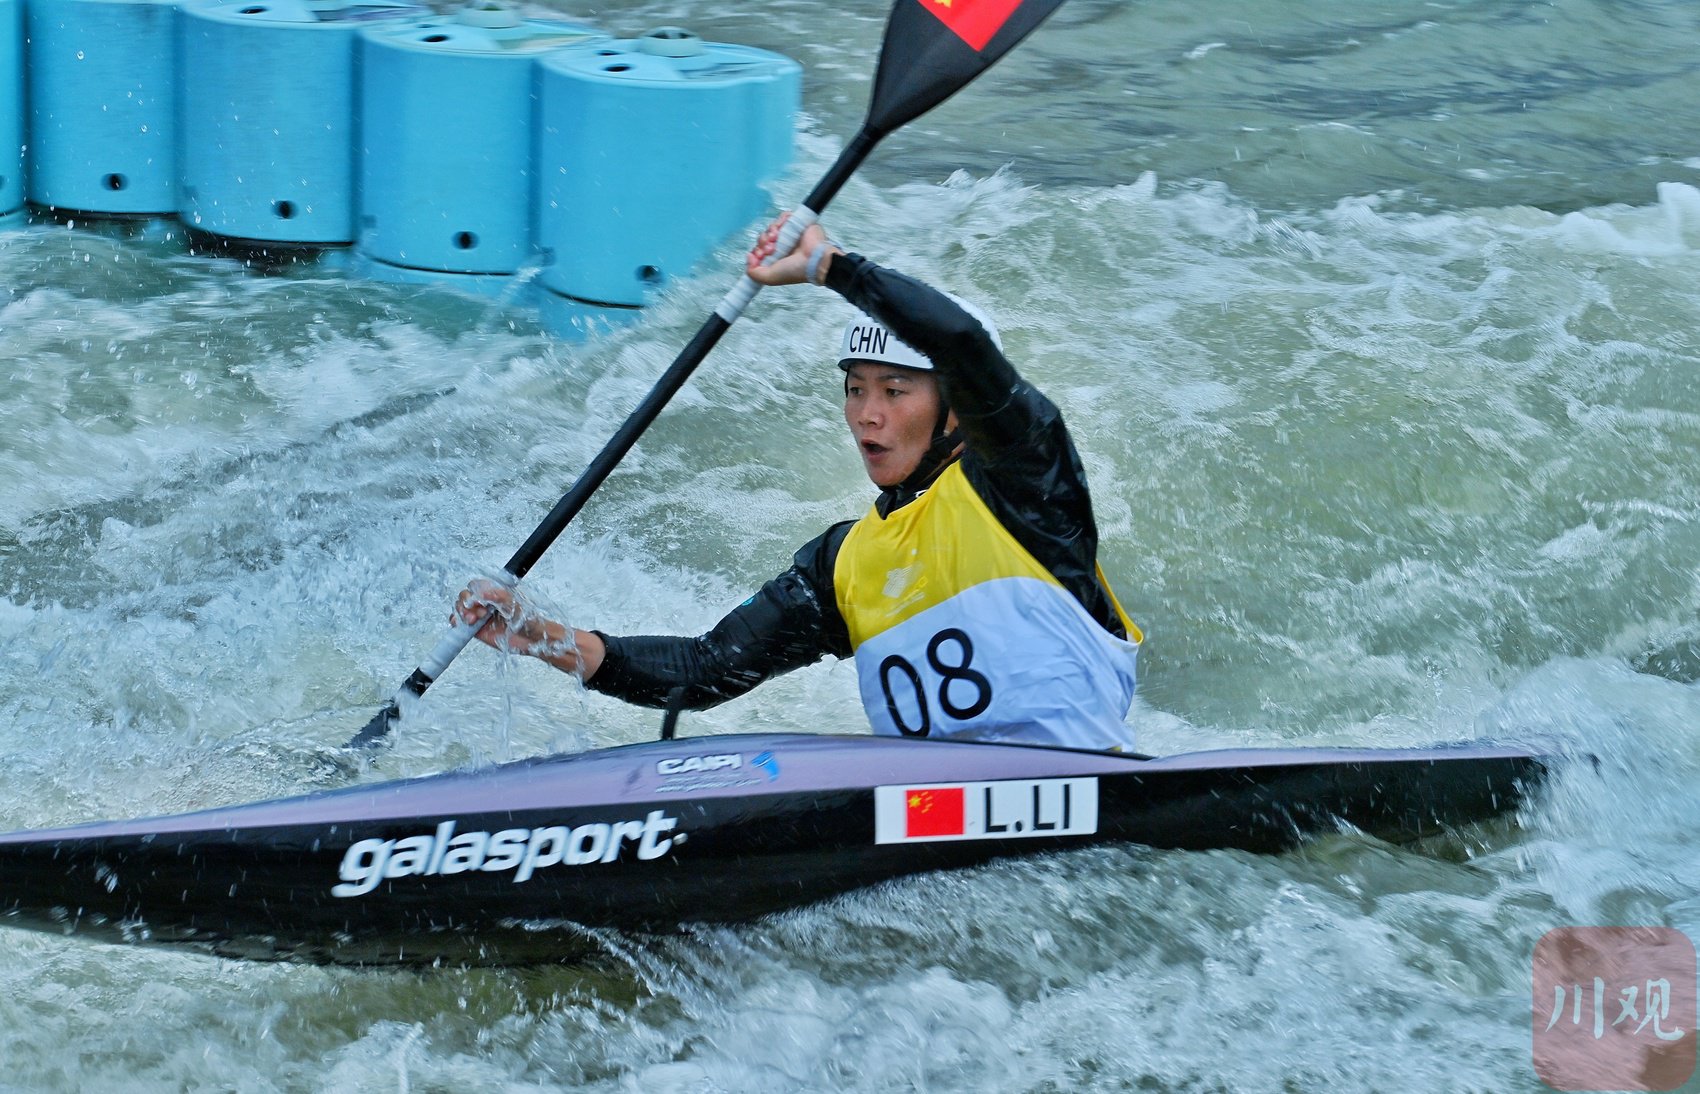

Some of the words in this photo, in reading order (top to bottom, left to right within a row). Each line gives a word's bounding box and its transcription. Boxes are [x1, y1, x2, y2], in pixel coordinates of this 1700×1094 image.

[849, 326, 889, 354] CHN
[880, 628, 992, 738] 08
[984, 784, 1071, 833] L.LI
[331, 809, 677, 898] galasport
